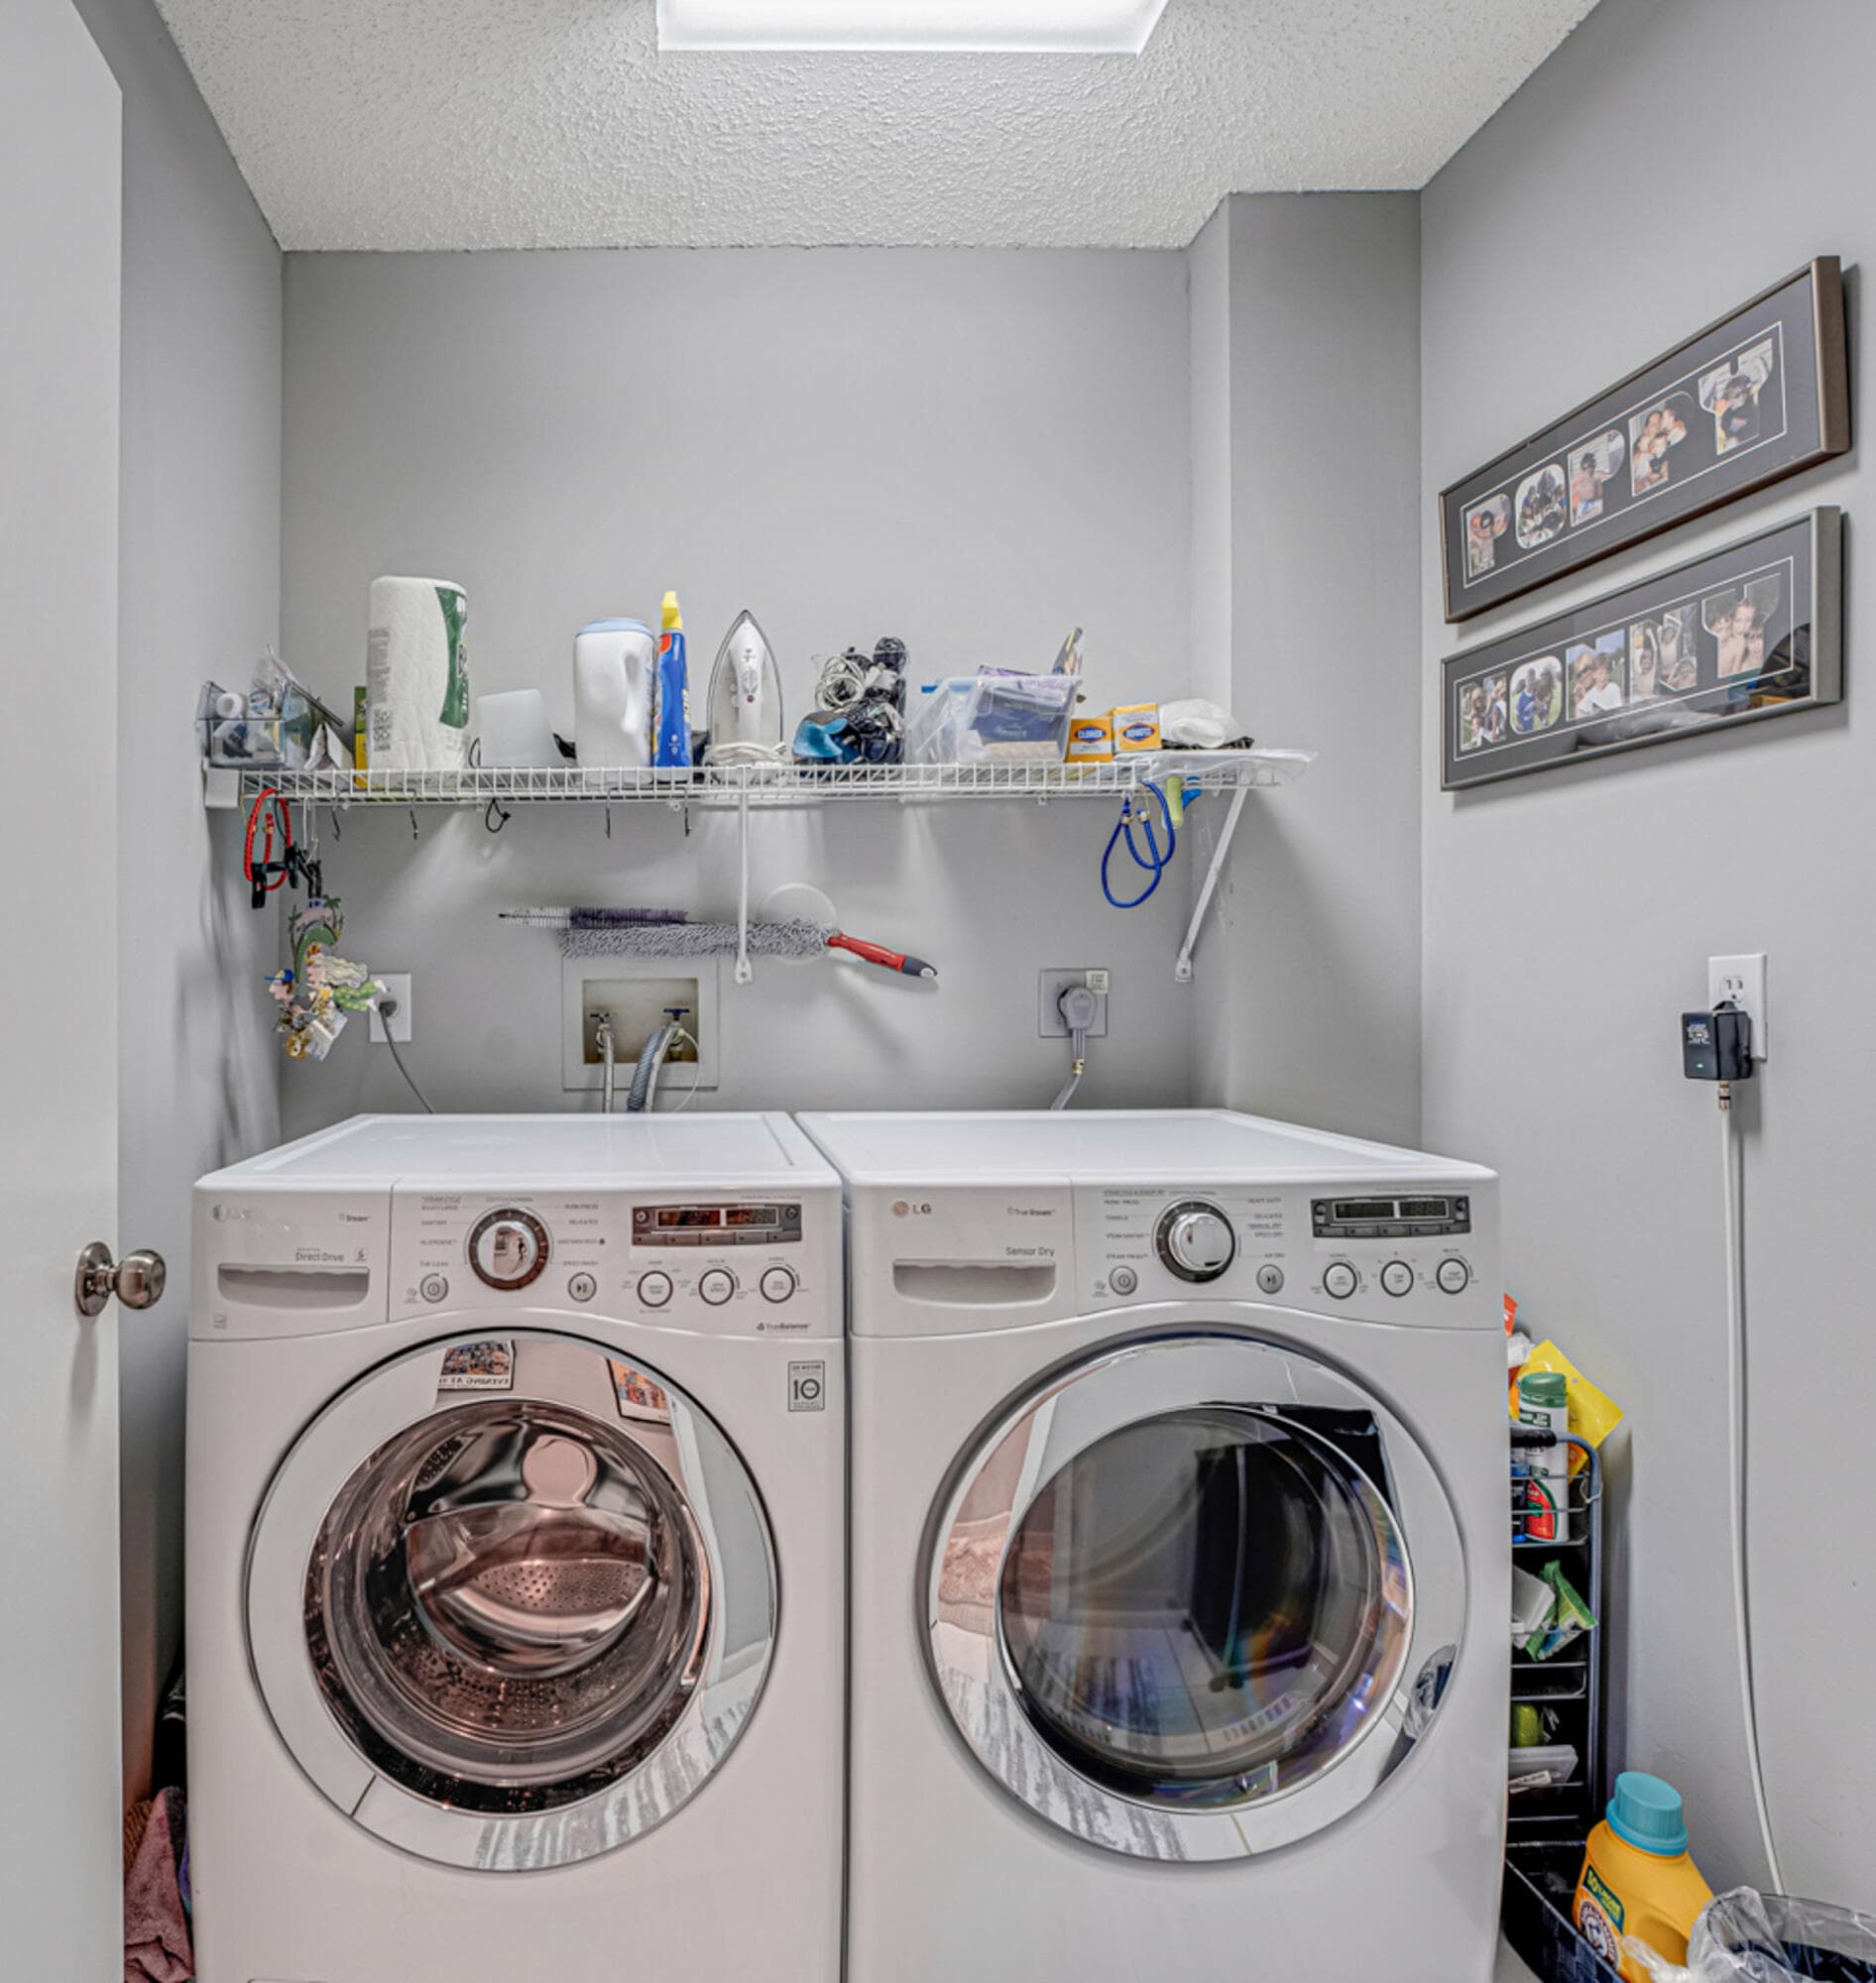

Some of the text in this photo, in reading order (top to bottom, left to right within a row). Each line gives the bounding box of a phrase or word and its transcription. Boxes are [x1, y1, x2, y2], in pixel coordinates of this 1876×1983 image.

[912, 1203, 932, 1215] LG
[295, 1251, 345, 1262] Direct Drive
[1005, 1246, 1055, 1257] Sensor Dry
